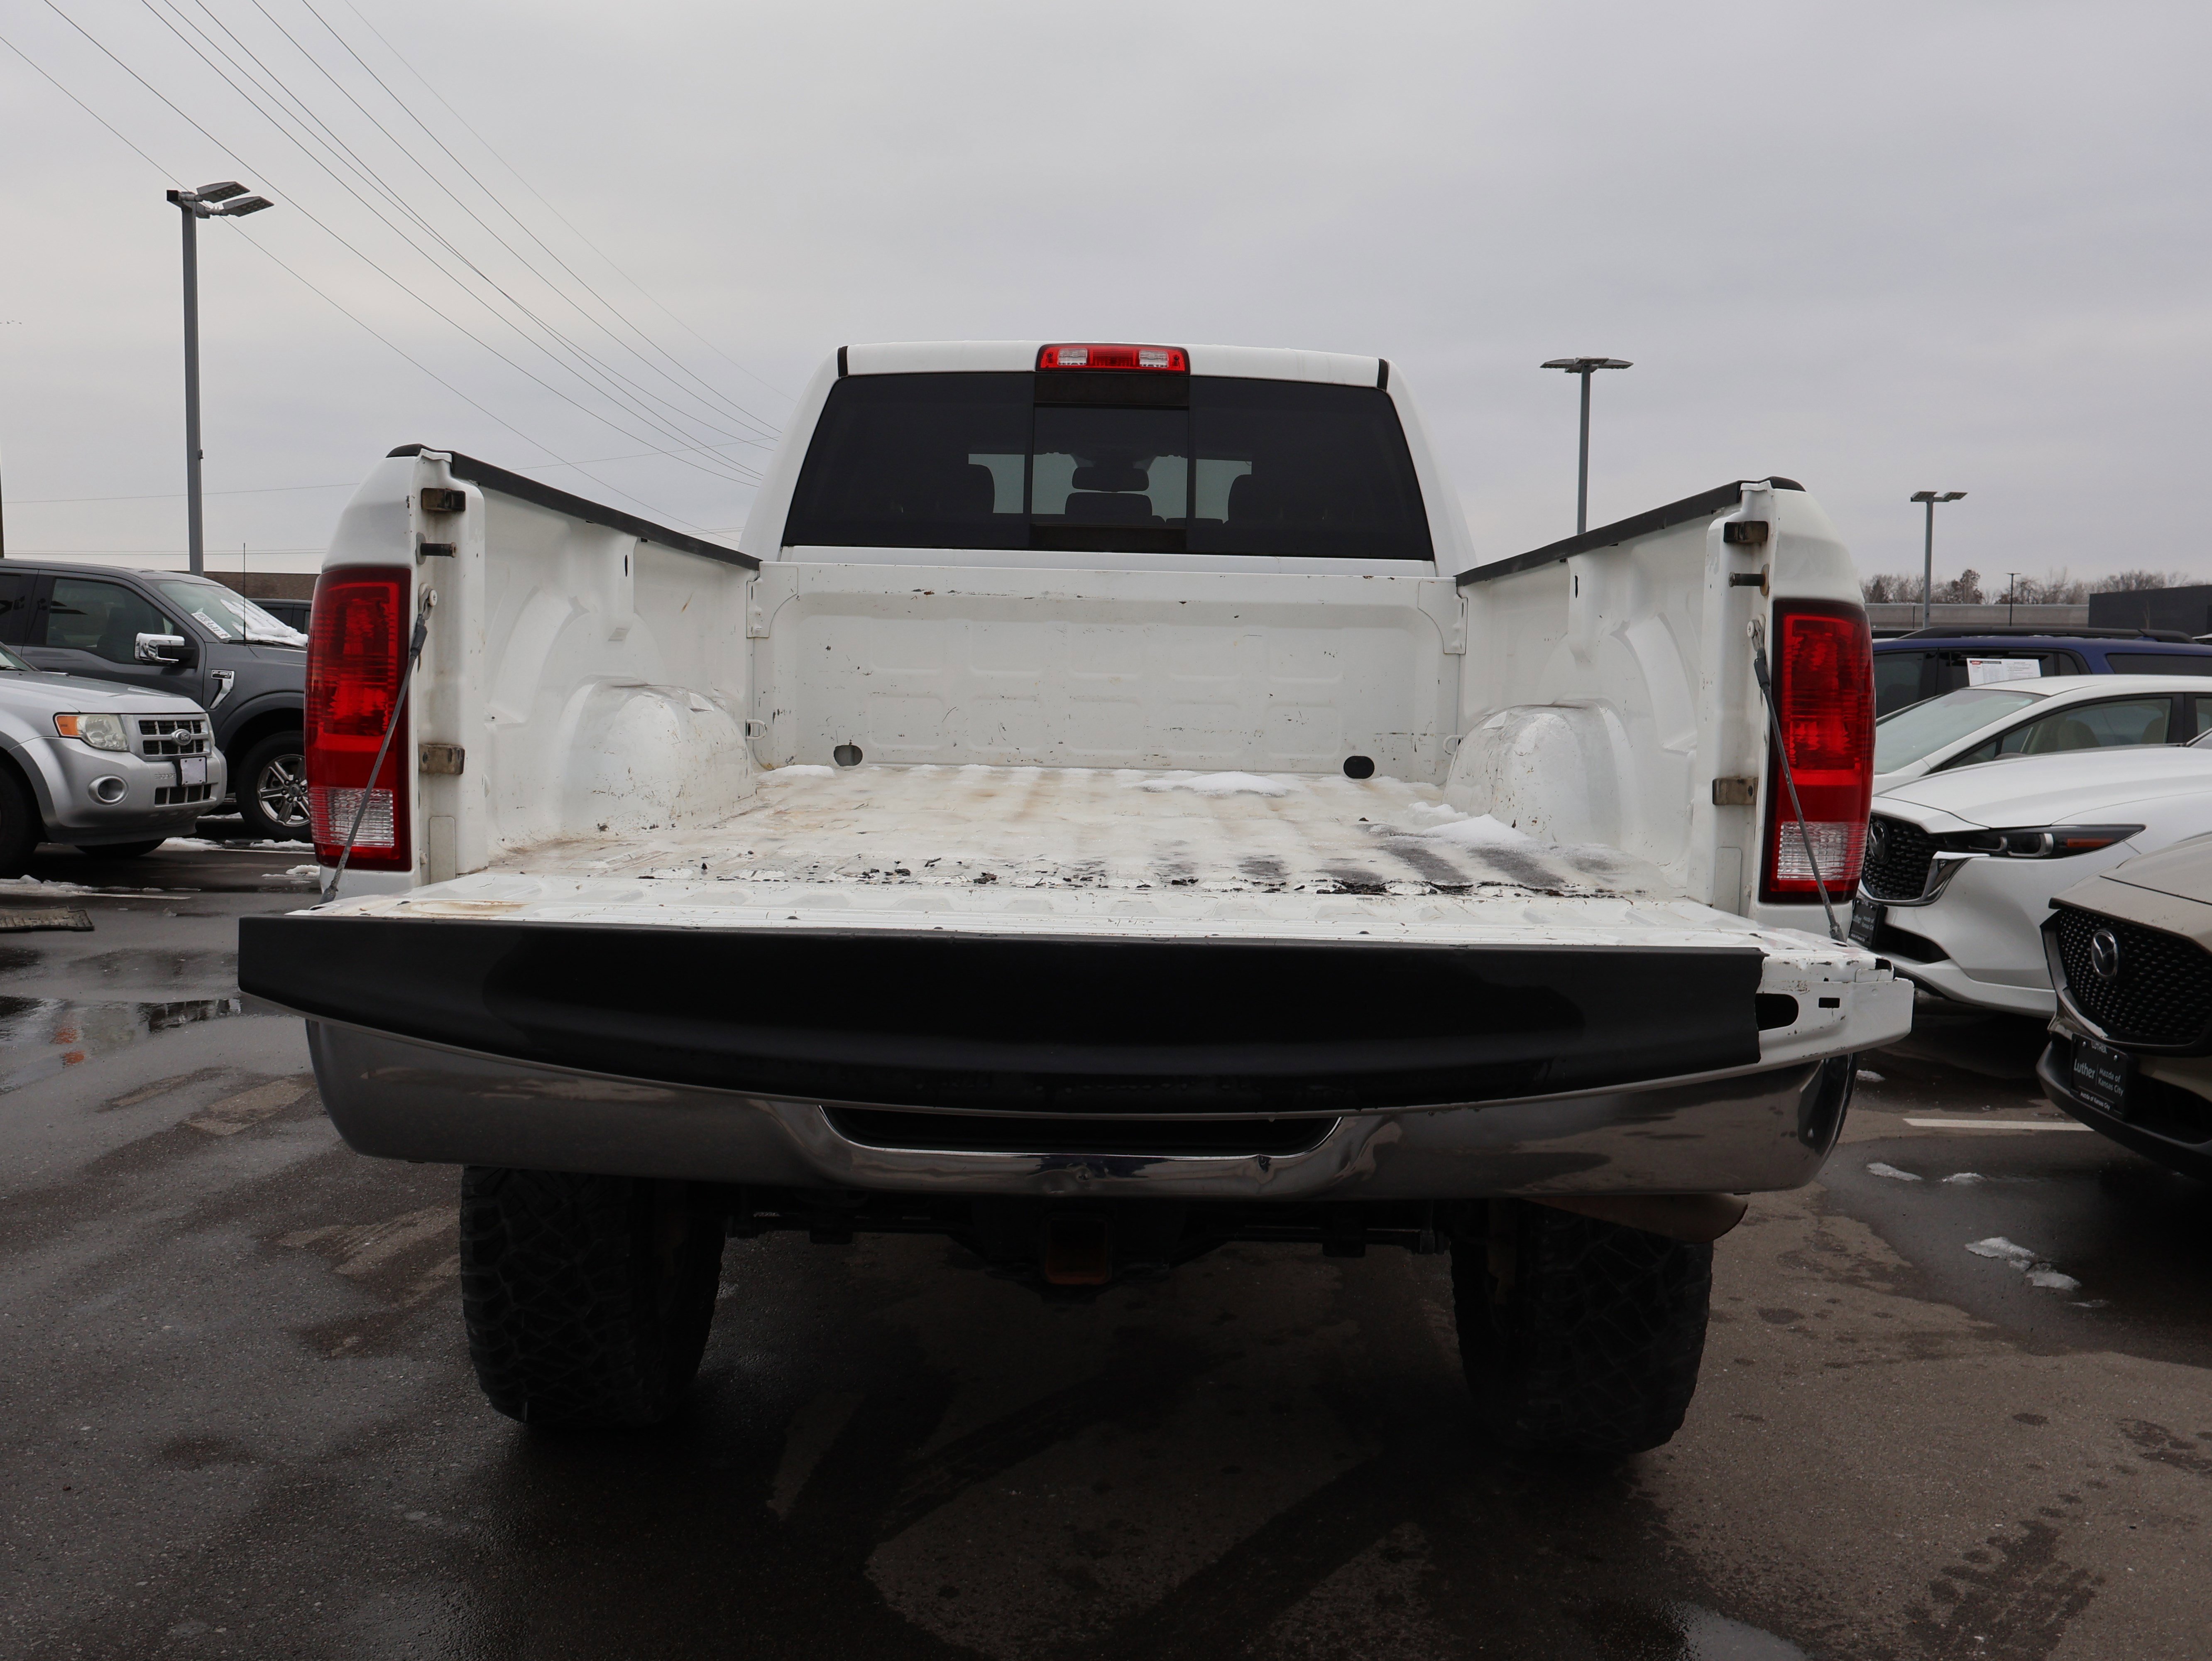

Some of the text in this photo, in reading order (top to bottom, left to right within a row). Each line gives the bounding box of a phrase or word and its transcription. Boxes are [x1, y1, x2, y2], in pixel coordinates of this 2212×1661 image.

[2091, 1040, 2107, 1054] LUTHER
[2074, 1058, 2096, 1079] Luther
[2099, 1068, 2121, 1083] Mazda of
[2098, 1077, 2124, 1097] Kansas City
[2080, 1092, 2090, 1100] Mazda
[2094, 1098, 2104, 1107] Kansas
